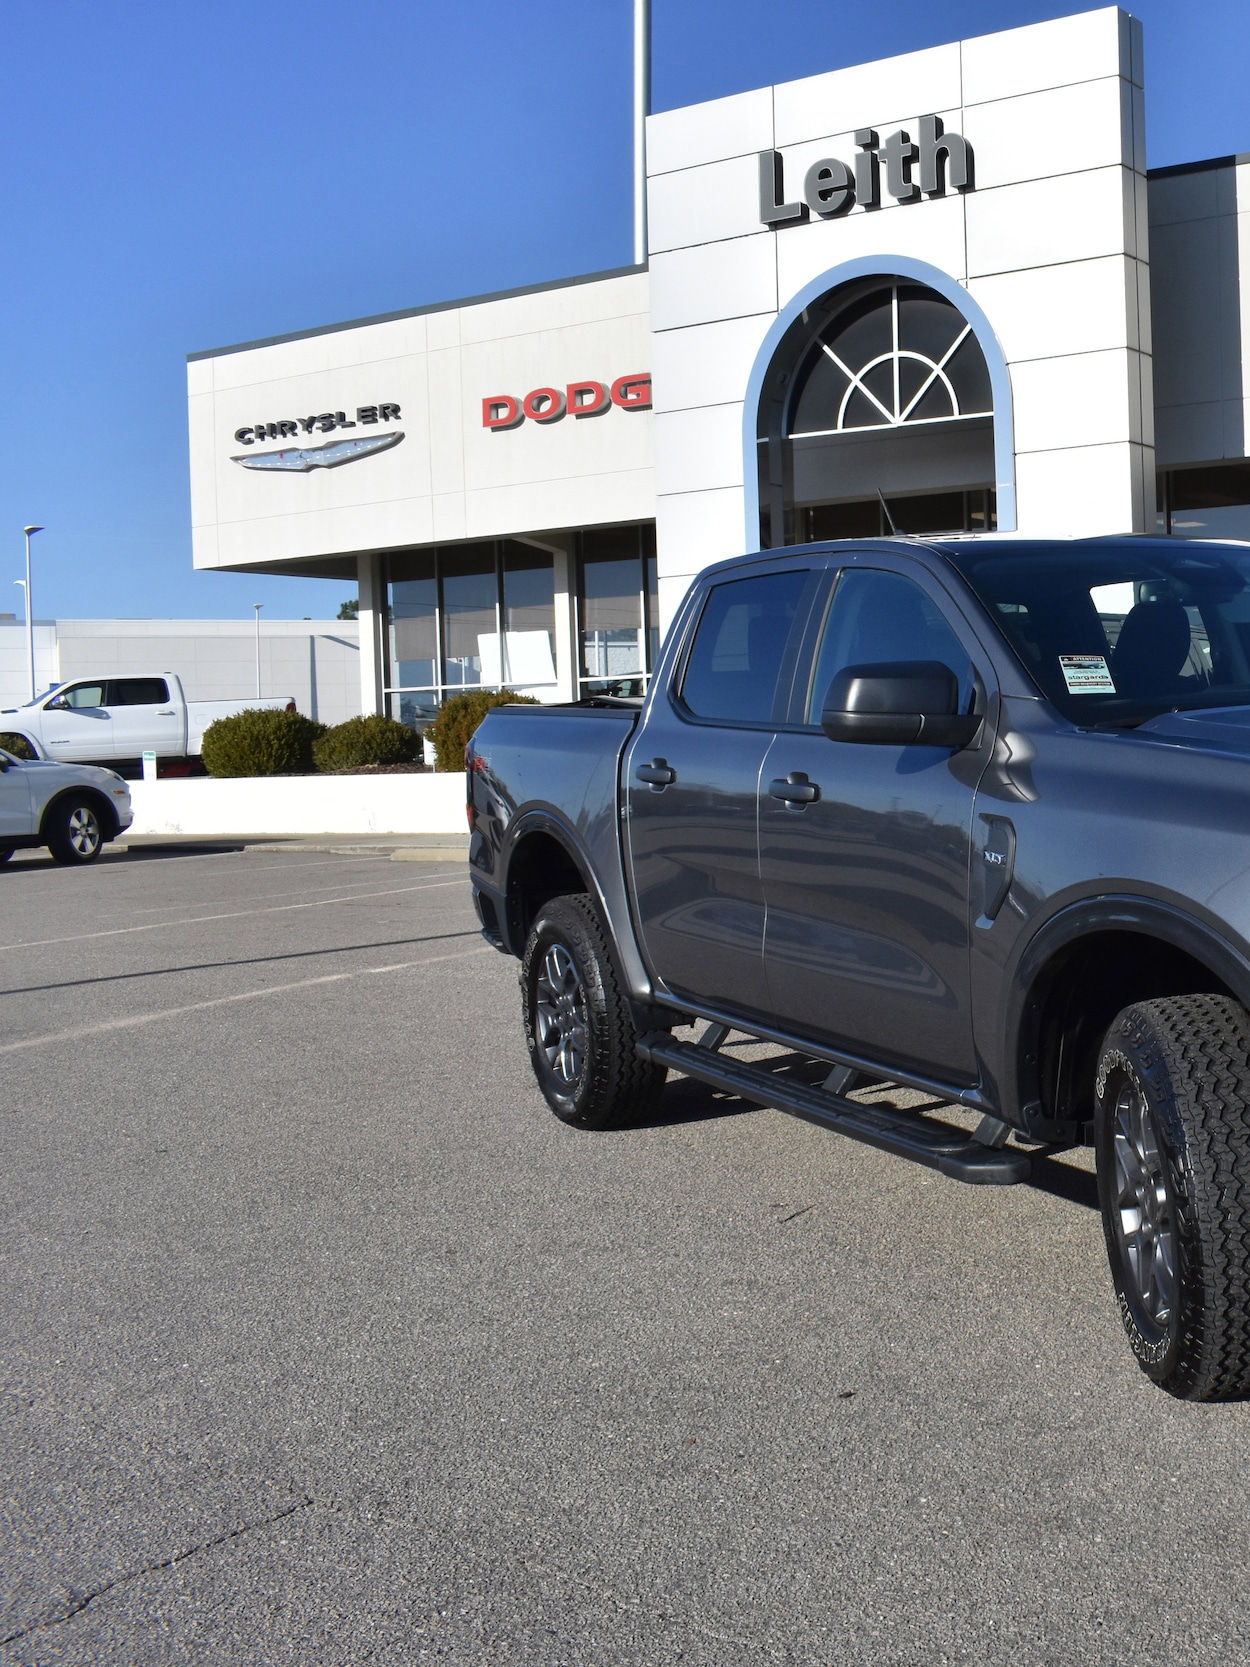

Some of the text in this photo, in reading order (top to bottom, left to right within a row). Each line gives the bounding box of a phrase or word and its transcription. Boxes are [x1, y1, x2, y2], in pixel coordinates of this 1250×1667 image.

[758, 114, 975, 231] Leith
[234, 402, 402, 446] CHRYSLER
[482, 372, 653, 432] DODG
